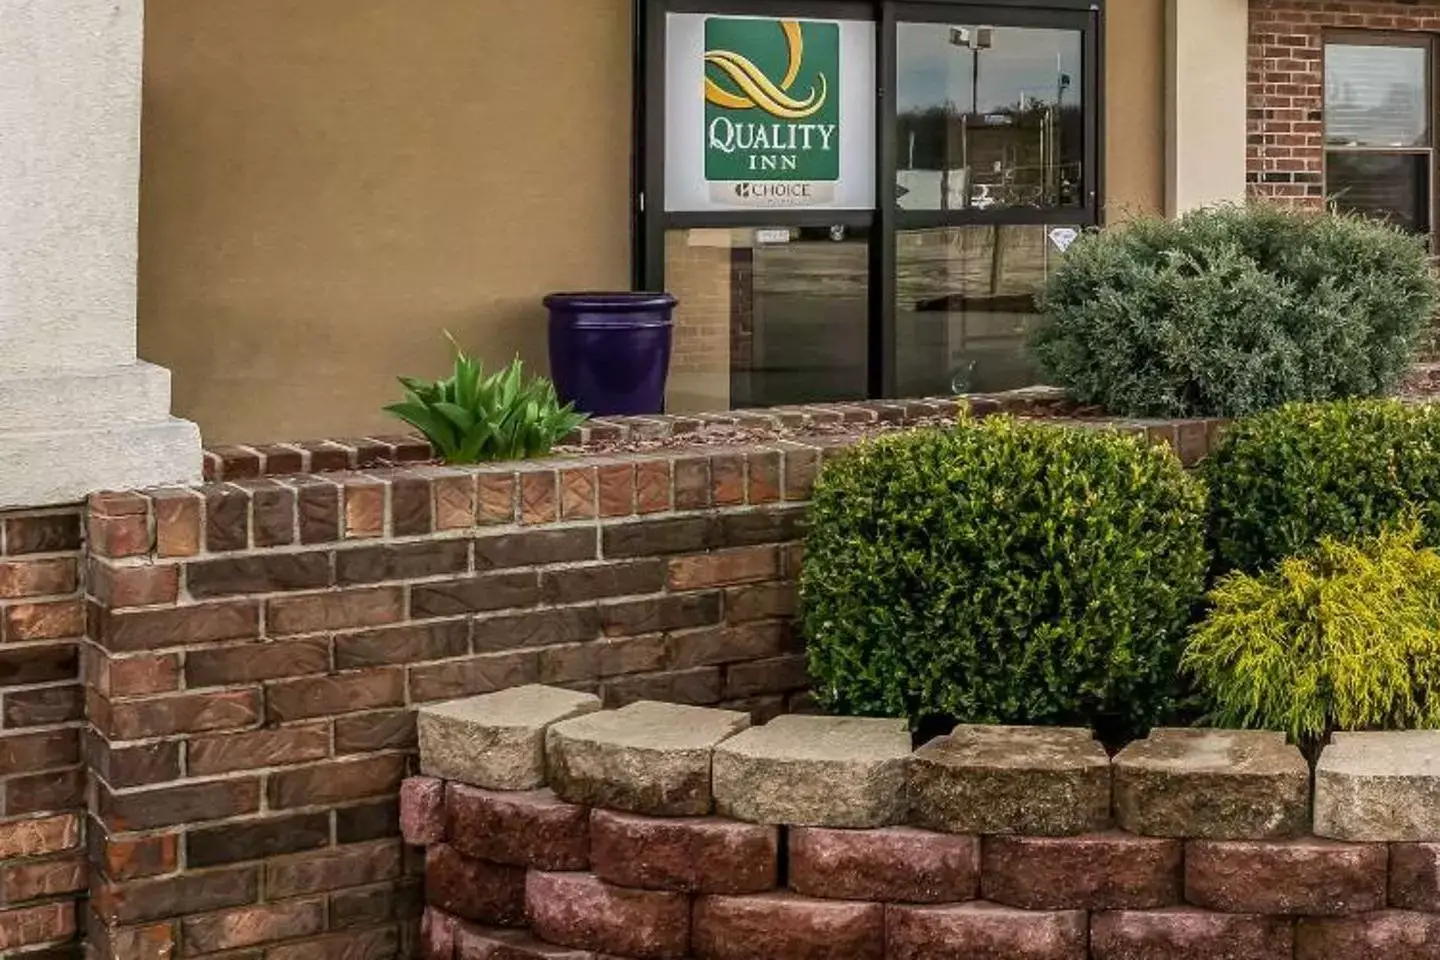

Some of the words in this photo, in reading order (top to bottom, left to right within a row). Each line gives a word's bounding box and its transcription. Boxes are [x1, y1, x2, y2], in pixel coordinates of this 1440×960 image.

[709, 116, 836, 153] QUALITY
[748, 155, 797, 170] INN
[752, 184, 812, 197] CHOICE
